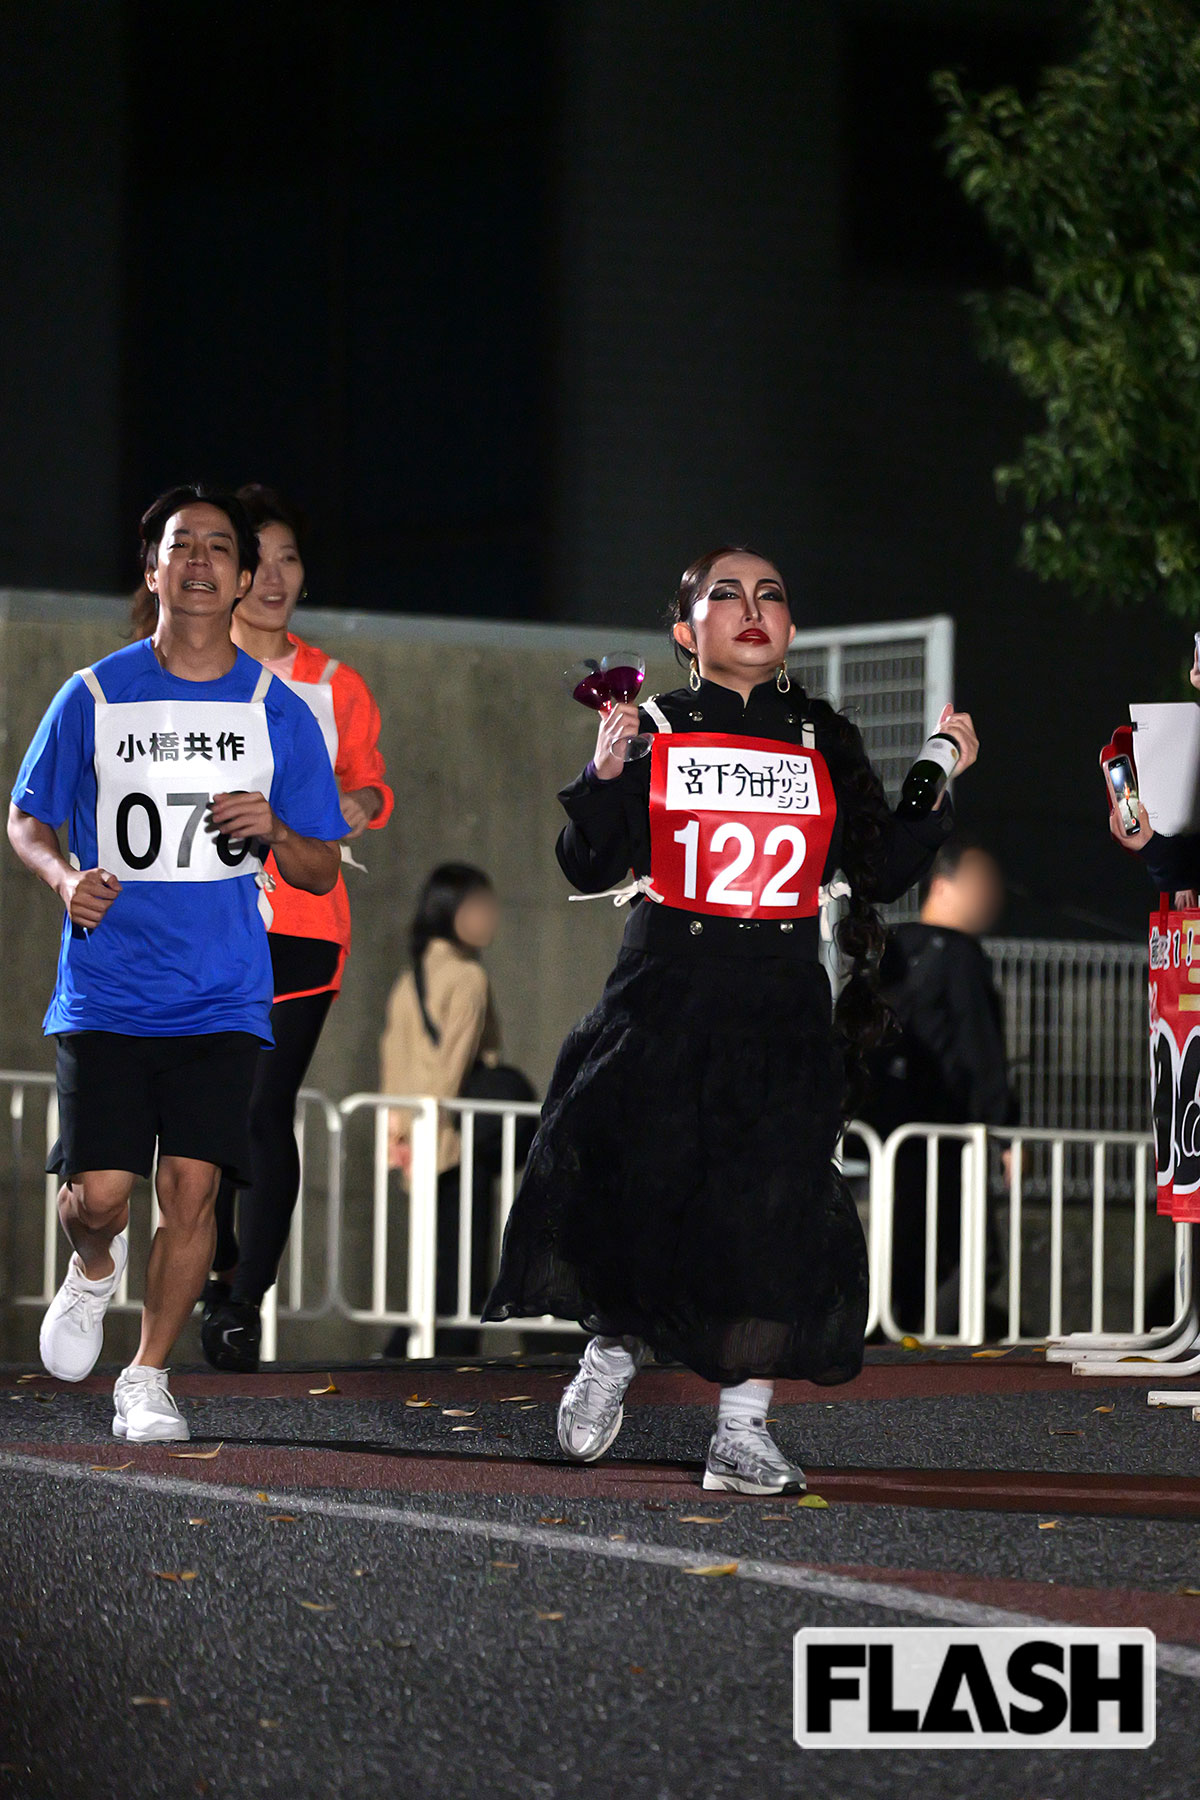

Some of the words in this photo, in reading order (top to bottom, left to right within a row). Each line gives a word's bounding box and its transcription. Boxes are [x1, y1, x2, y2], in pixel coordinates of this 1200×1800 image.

[116, 731, 245, 763] 小橋共作
[677, 757, 780, 798] 宮下今日子
[673, 819, 806, 907] 122
